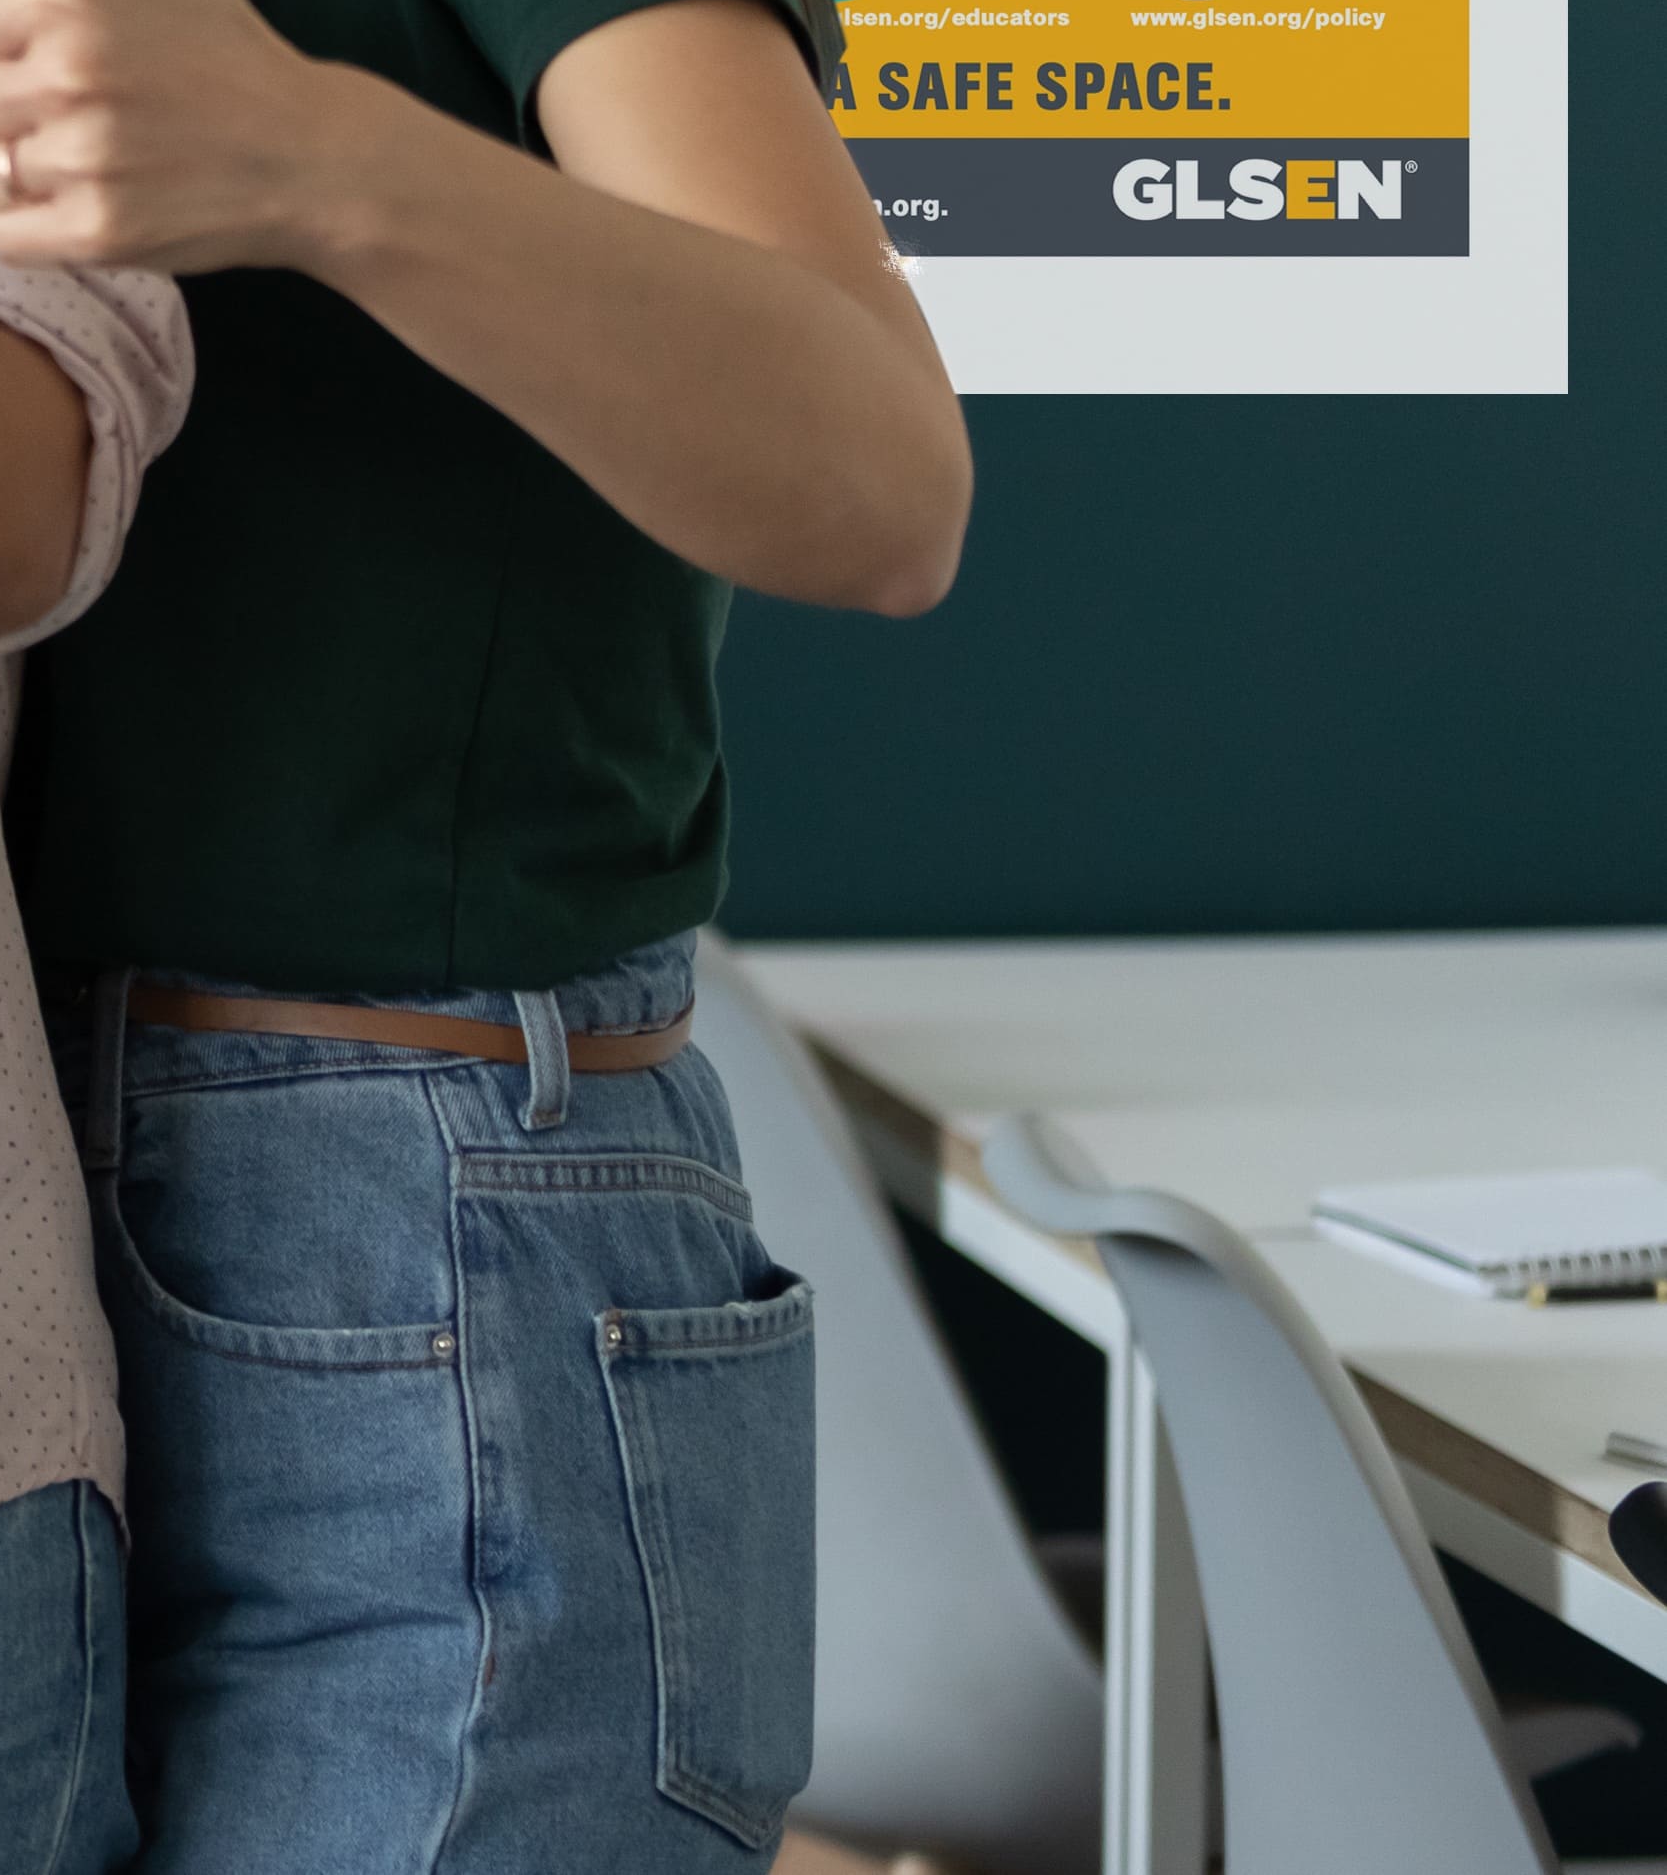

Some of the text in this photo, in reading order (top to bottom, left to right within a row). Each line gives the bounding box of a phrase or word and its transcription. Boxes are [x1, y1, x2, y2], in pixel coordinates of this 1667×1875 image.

[839, 7, 1071, 30] lsen.org/educators
[1130, 7, 1386, 30] www.glsen.org/policy
[828, 61, 1232, 112] A SAFE SPACE.
